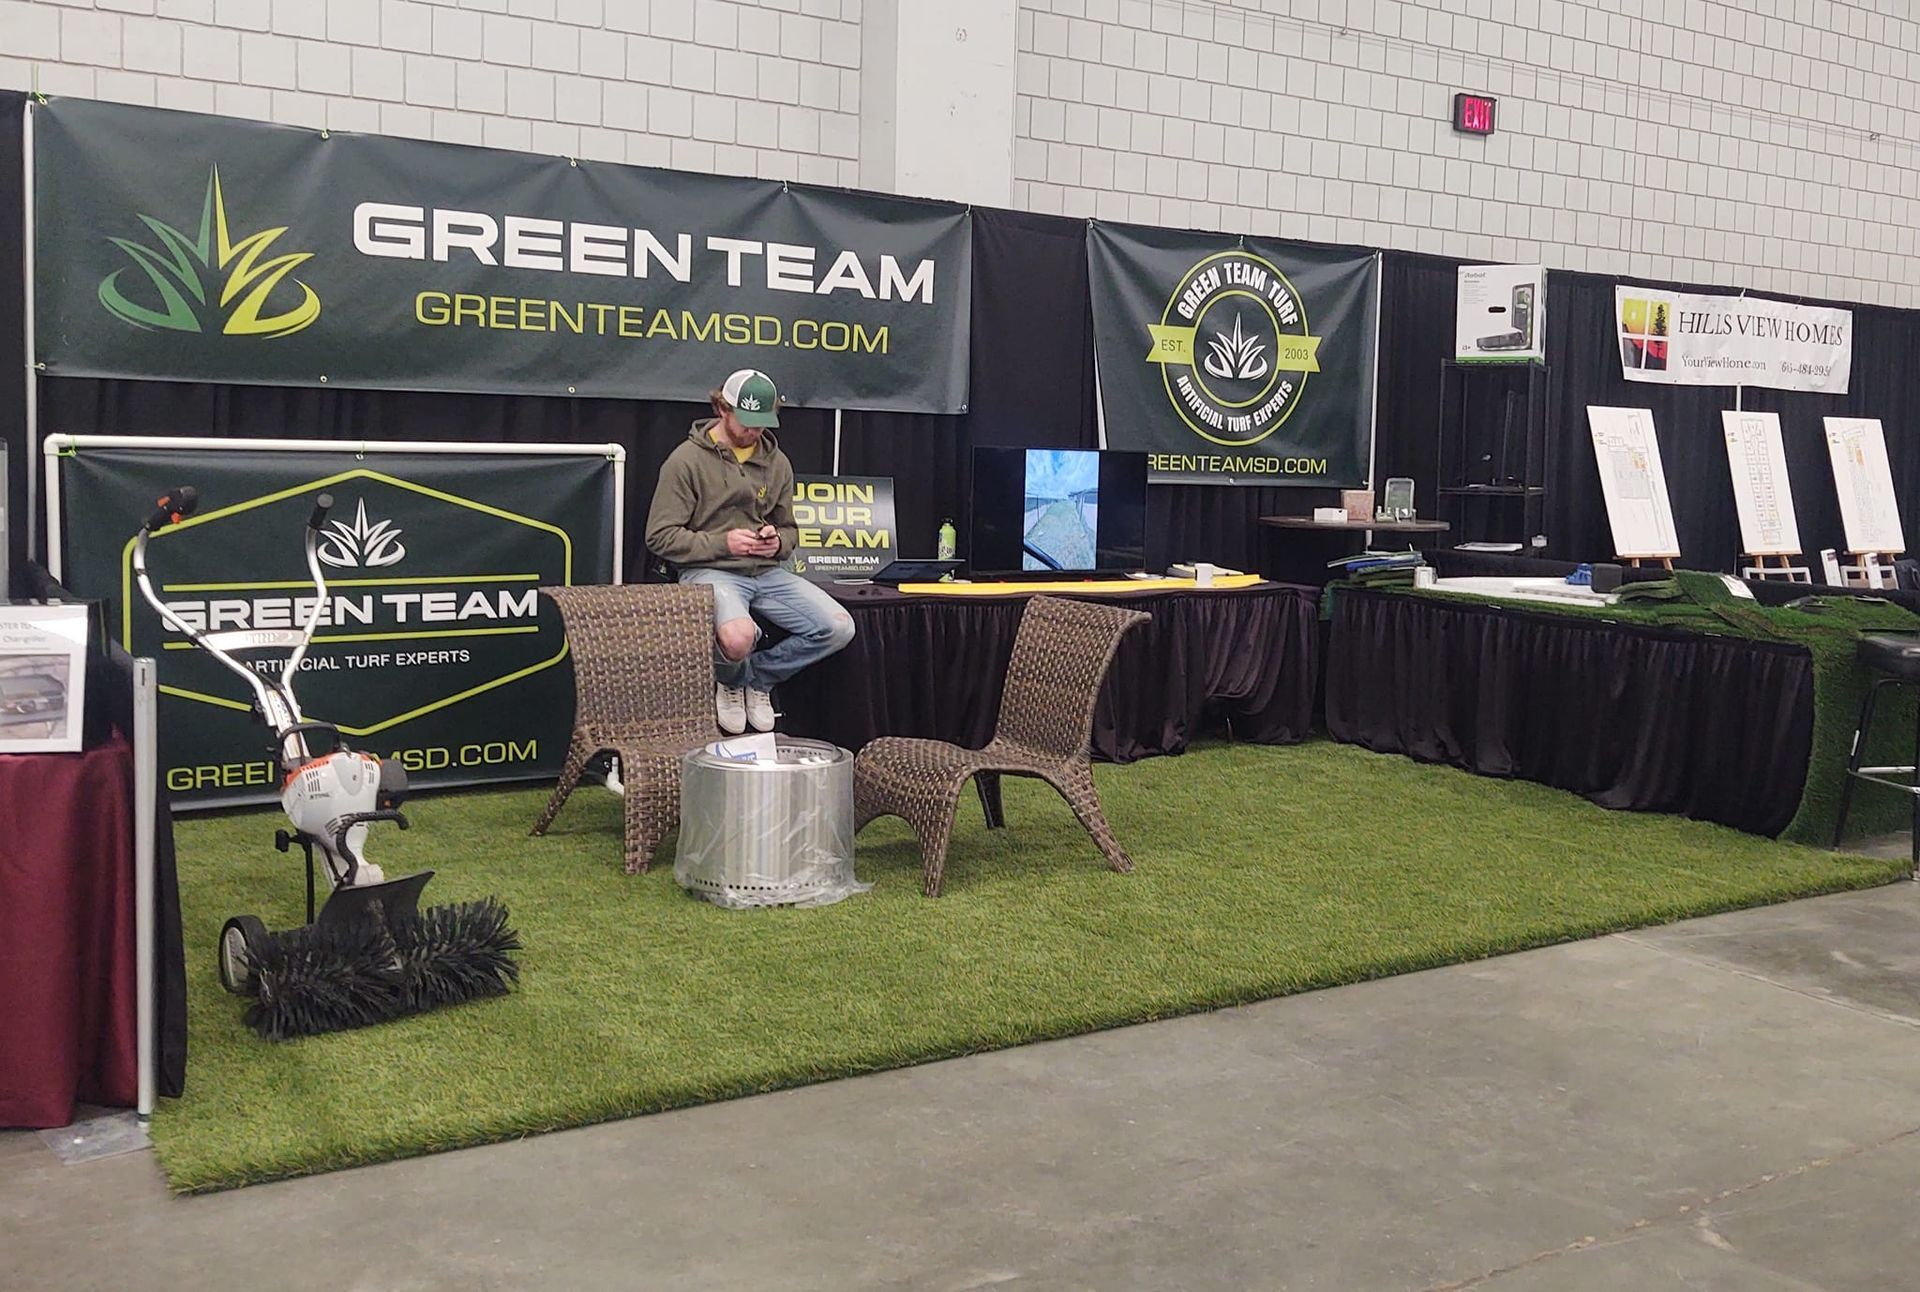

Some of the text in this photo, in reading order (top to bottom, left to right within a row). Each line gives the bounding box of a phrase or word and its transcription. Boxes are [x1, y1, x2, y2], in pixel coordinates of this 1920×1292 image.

[1464, 96, 1492, 130] EXIT
[353, 201, 935, 305] GREEN TEAM
[1177, 262, 1299, 326] GREEN TEAM TURF
[415, 291, 889, 355] GREENTEAMSD.COM
[1678, 311, 1843, 346] HILLS VIEW HOMES
[1161, 339, 1187, 352] EST.
[1284, 348, 1309, 360] 2003
[1176, 375, 1293, 433] ARTIFICIAL TURF EXPERTS
[1148, 453, 1327, 474] REENTEAMSD.COM
[793, 482, 874, 504] JOIN
[793, 505, 872, 526] OUR
[799, 528, 890, 549] EAM
[808, 555, 880, 564] GREEN TEAM
[162, 589, 539, 632] GREEN TEAM
[345, 653, 390, 668] TURF
[394, 649, 470, 666] EXPERTS
[166, 739, 538, 792] GREESD.COM
